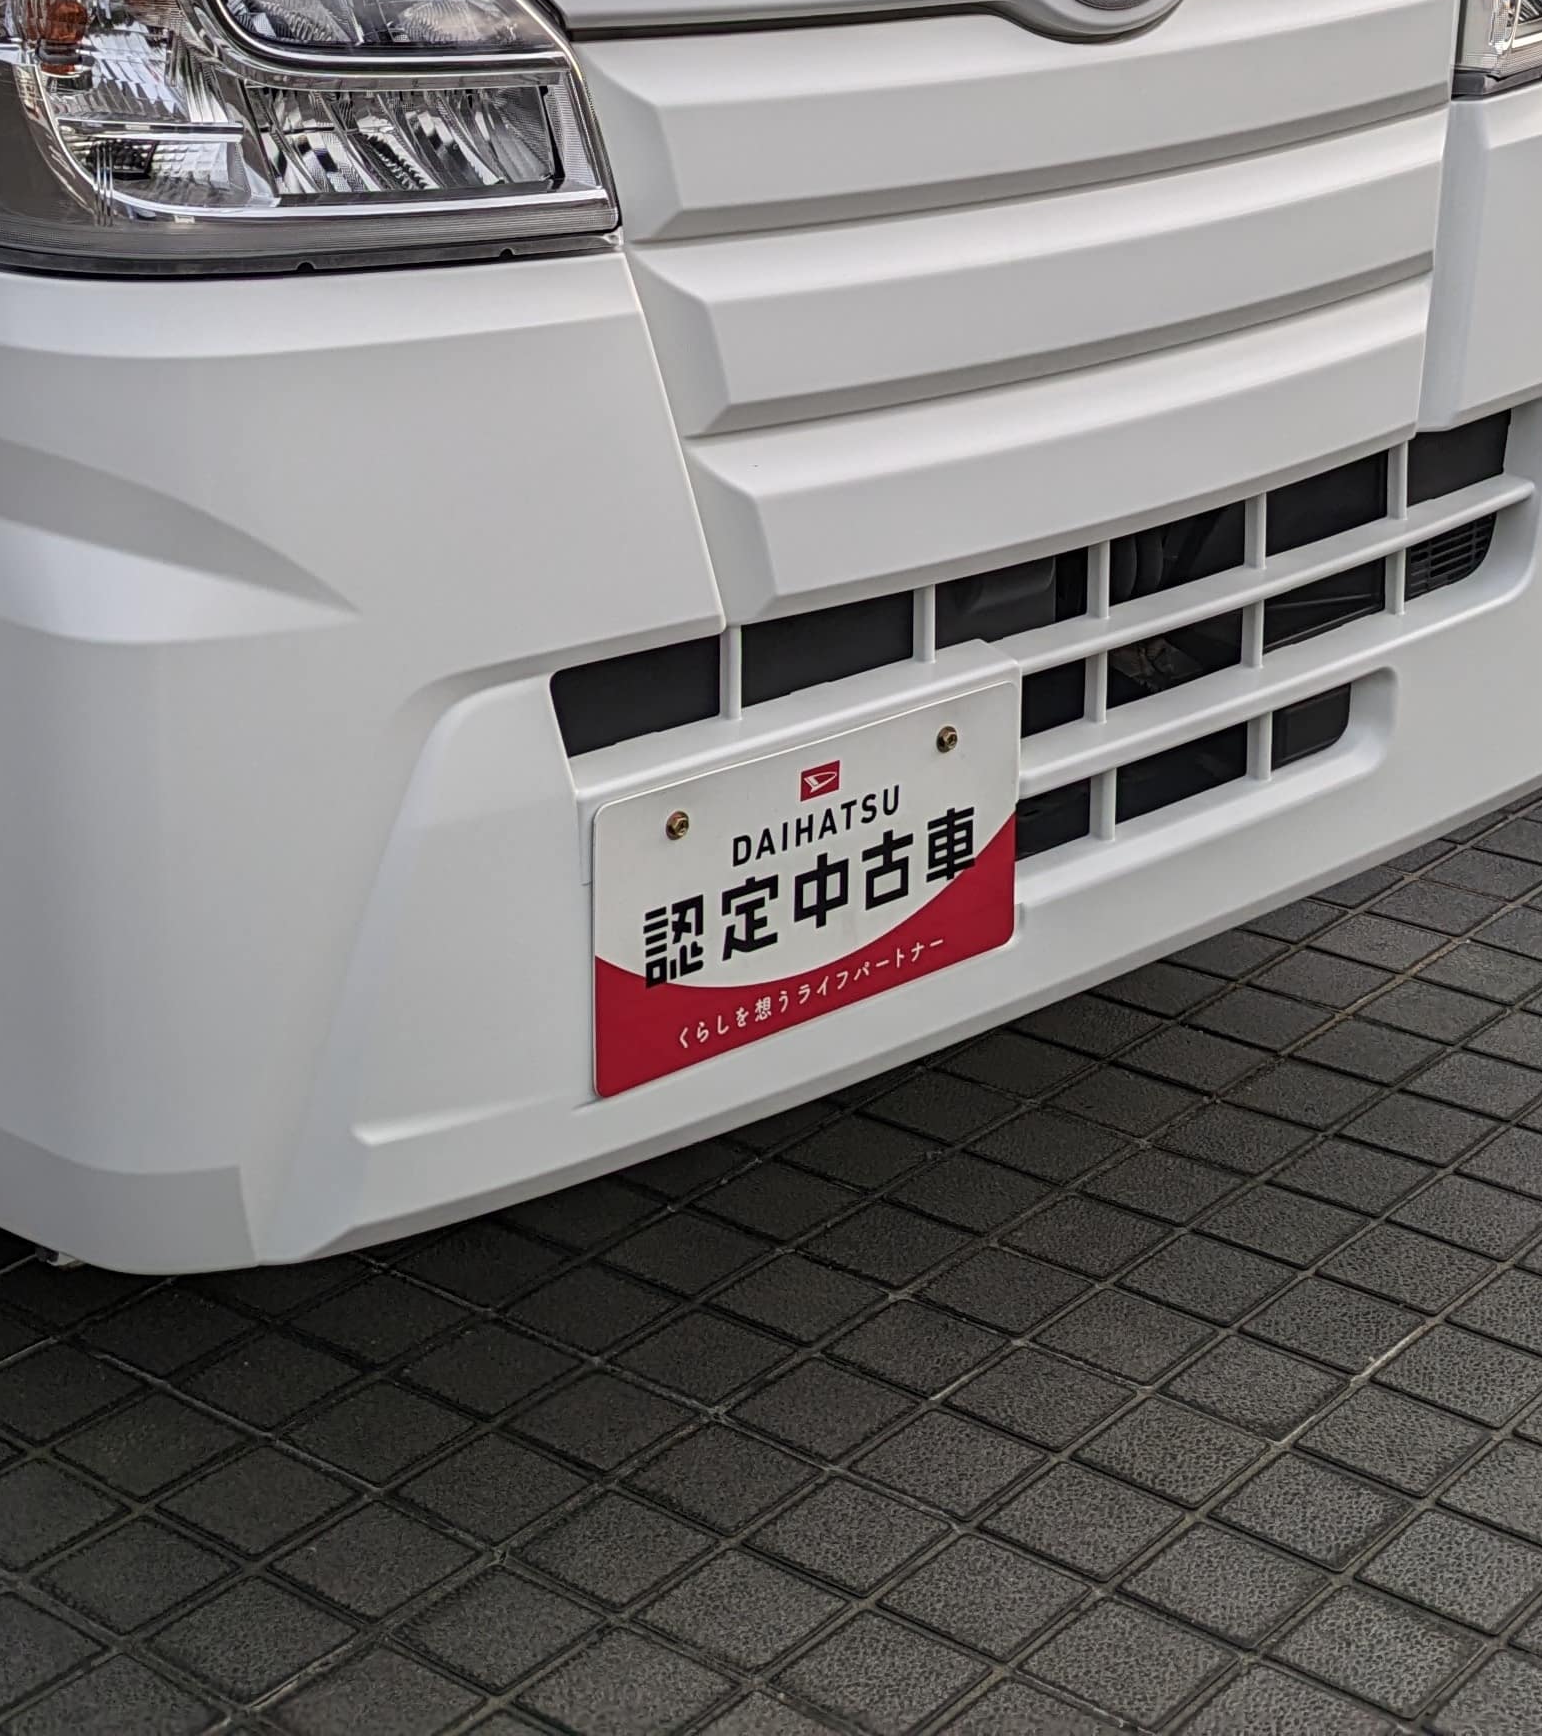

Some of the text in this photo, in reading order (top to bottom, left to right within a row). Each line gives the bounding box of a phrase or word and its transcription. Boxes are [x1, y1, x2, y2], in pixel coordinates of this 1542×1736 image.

[732, 784, 901, 867] DAIHATSU
[643, 806, 976, 990] 認定中古車
[677, 937, 945, 1050] くらしを想うライフパートナー
